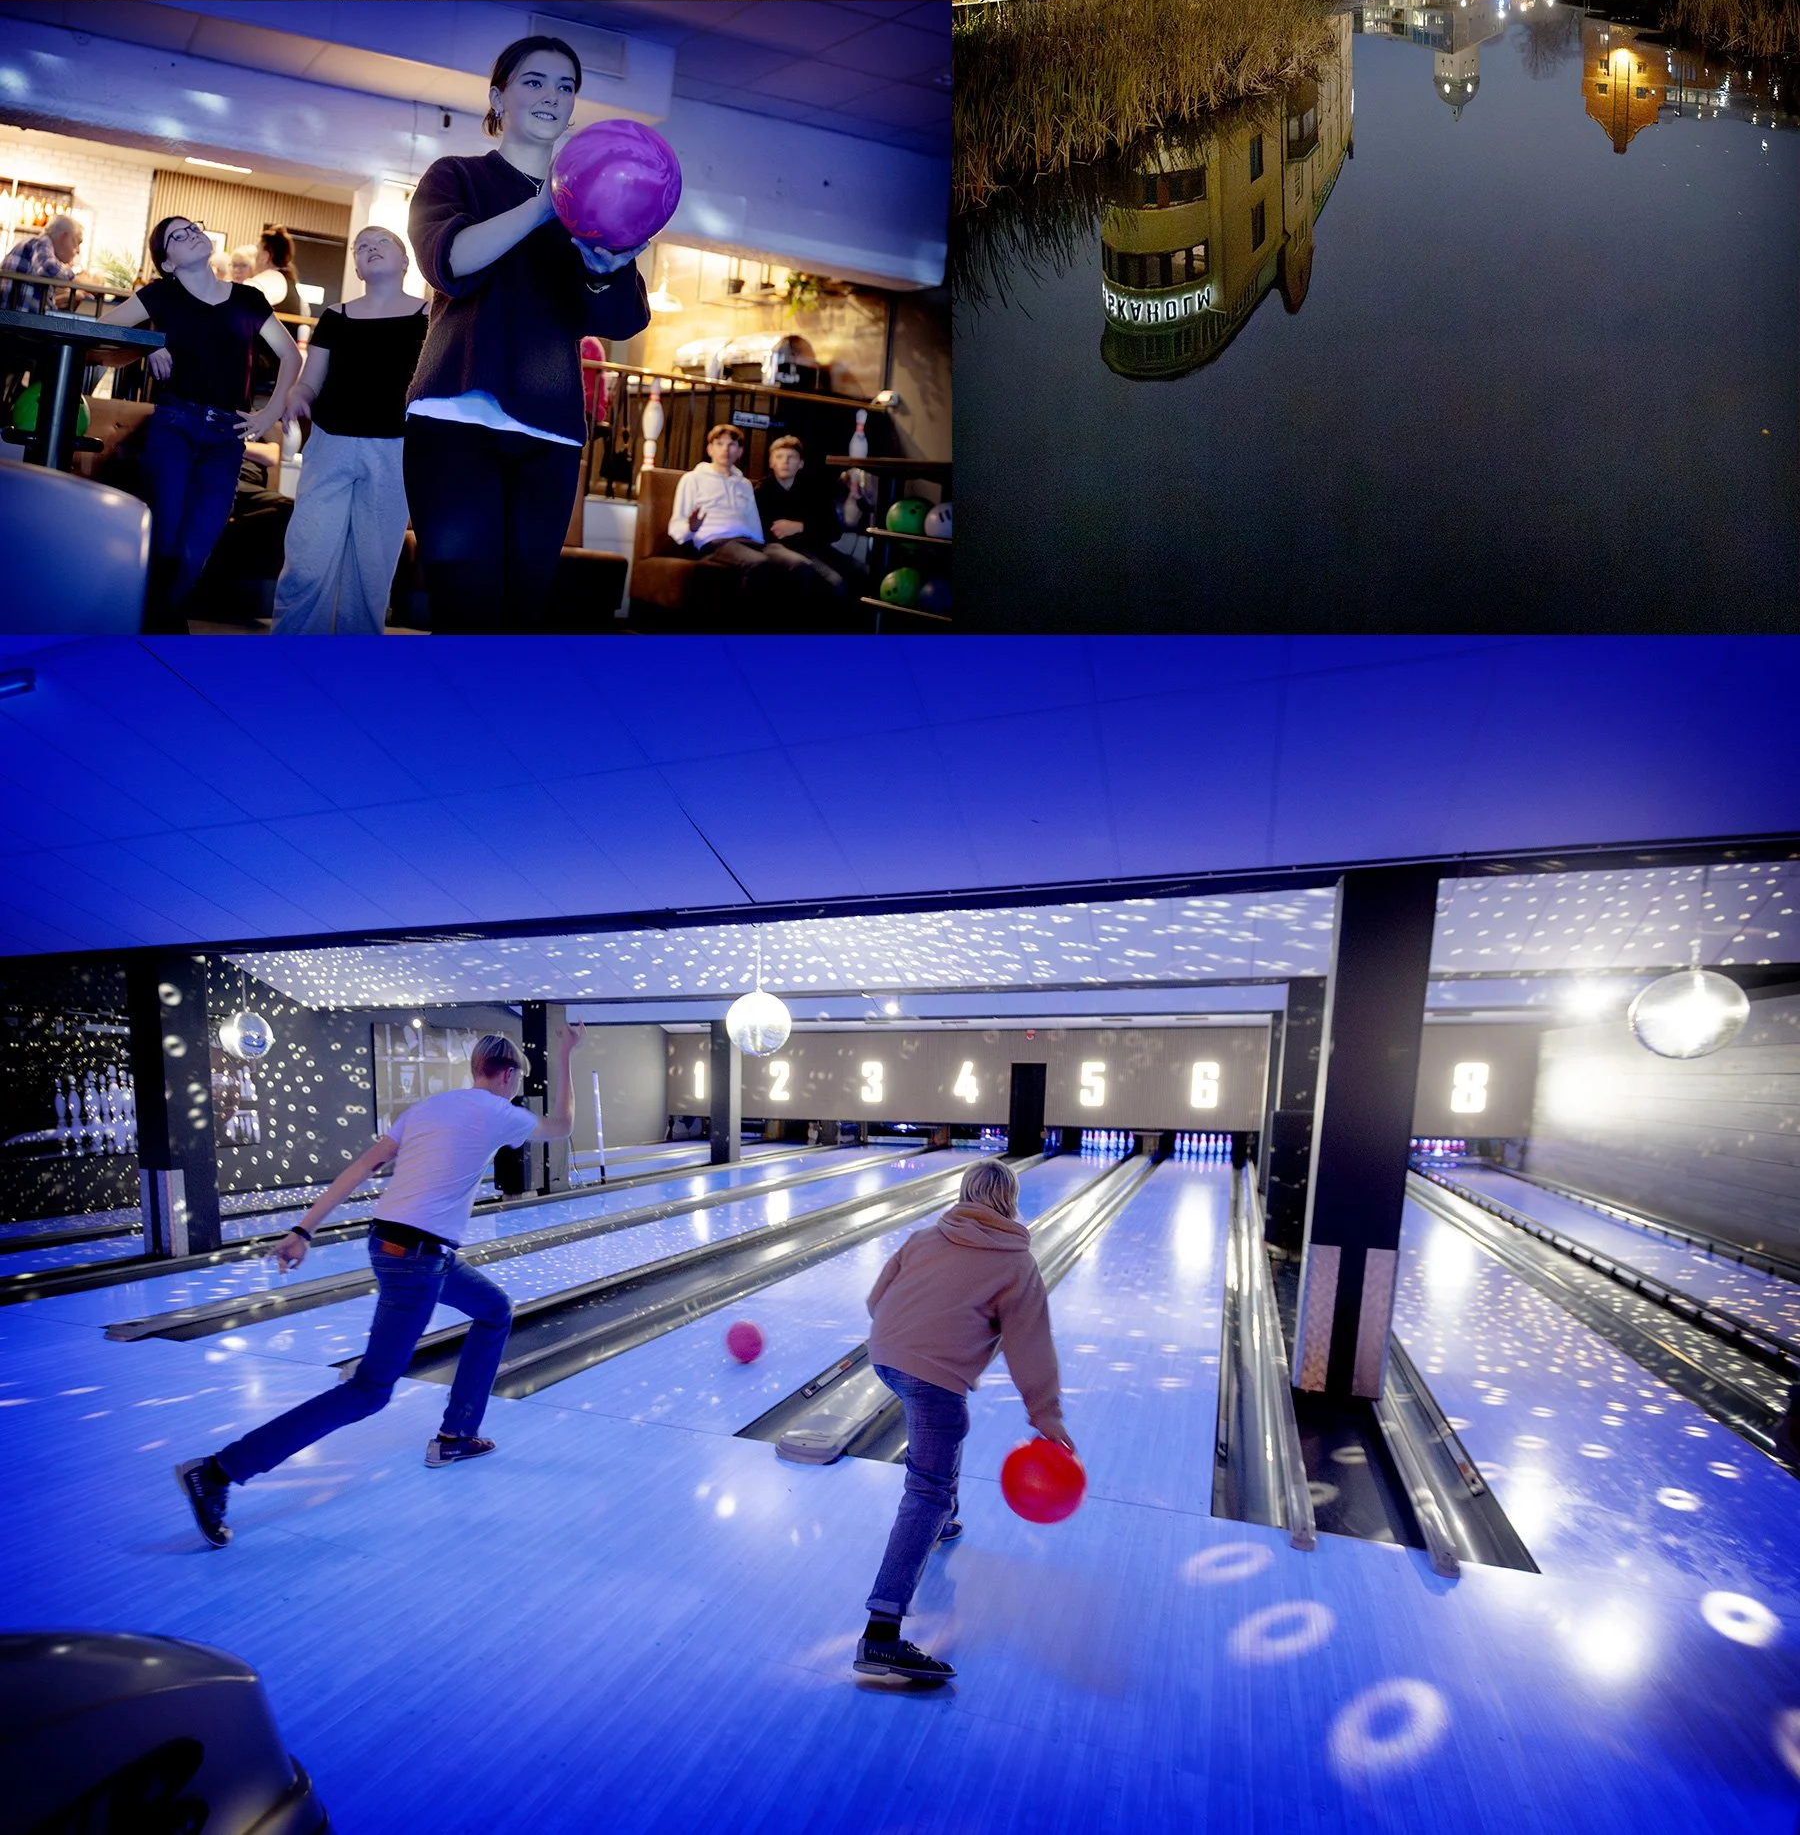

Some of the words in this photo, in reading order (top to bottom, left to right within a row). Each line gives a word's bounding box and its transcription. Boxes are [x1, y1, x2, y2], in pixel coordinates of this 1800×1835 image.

[694, 1061, 705, 1100] 1
[769, 1060, 790, 1101] 2
[861, 1061, 884, 1103] 3
[953, 1060, 980, 1104] 4
[1079, 1061, 1106, 1107] 5
[1190, 1061, 1220, 1109] 6
[1450, 1061, 1490, 1114] 8
